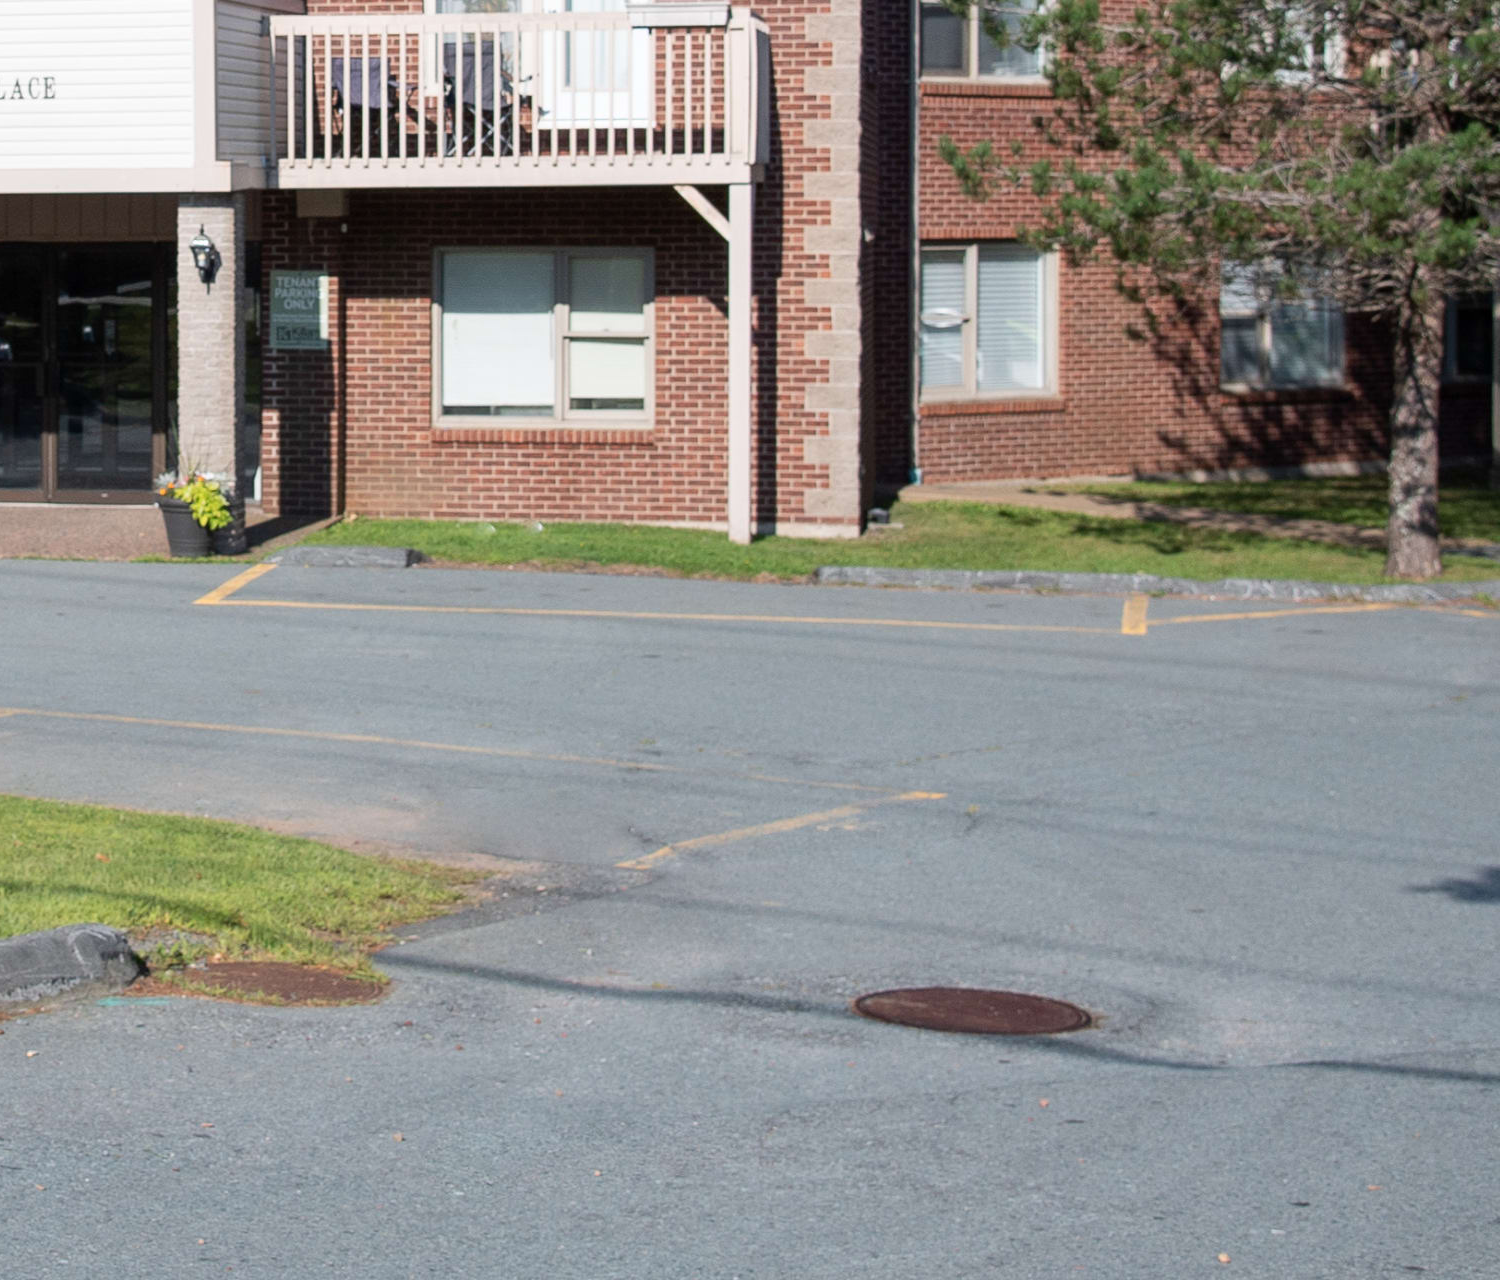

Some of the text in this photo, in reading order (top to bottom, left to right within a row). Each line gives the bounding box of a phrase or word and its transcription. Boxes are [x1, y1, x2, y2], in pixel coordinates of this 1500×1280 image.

[275, 276, 325, 288] TENAN
[274, 287, 326, 299] PARKIN
[283, 299, 316, 310] ONLY
